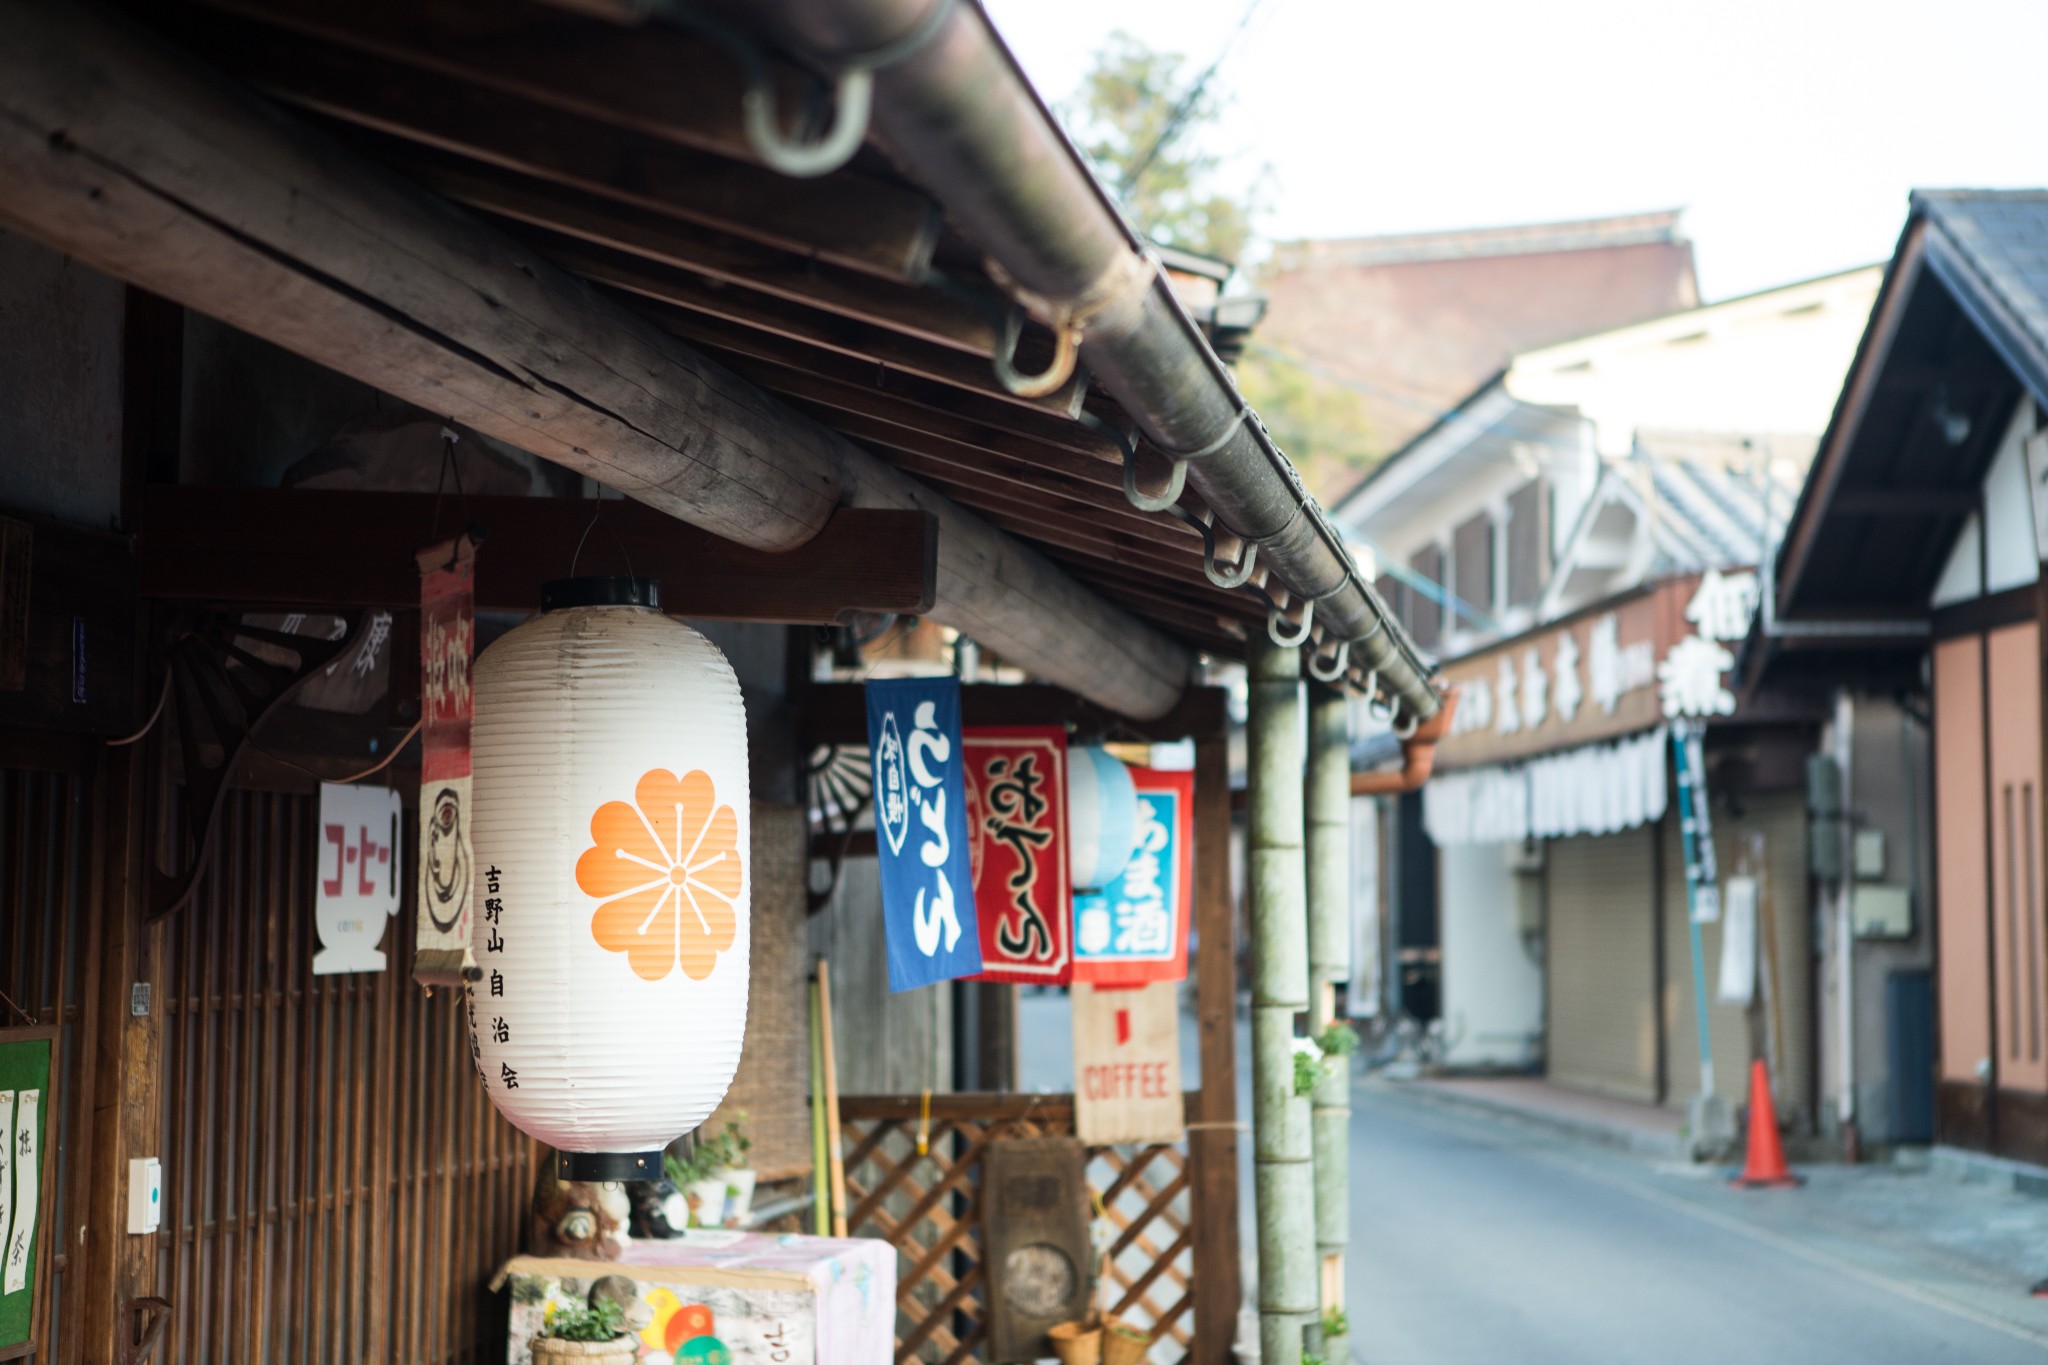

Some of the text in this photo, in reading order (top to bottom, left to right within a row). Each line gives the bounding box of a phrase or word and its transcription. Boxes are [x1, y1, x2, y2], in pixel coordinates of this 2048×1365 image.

[323, 824, 390, 898] コーヒー
[485, 865, 519, 1090] 吉野山自治会
[1083, 1063, 1169, 1101] COFFEE
